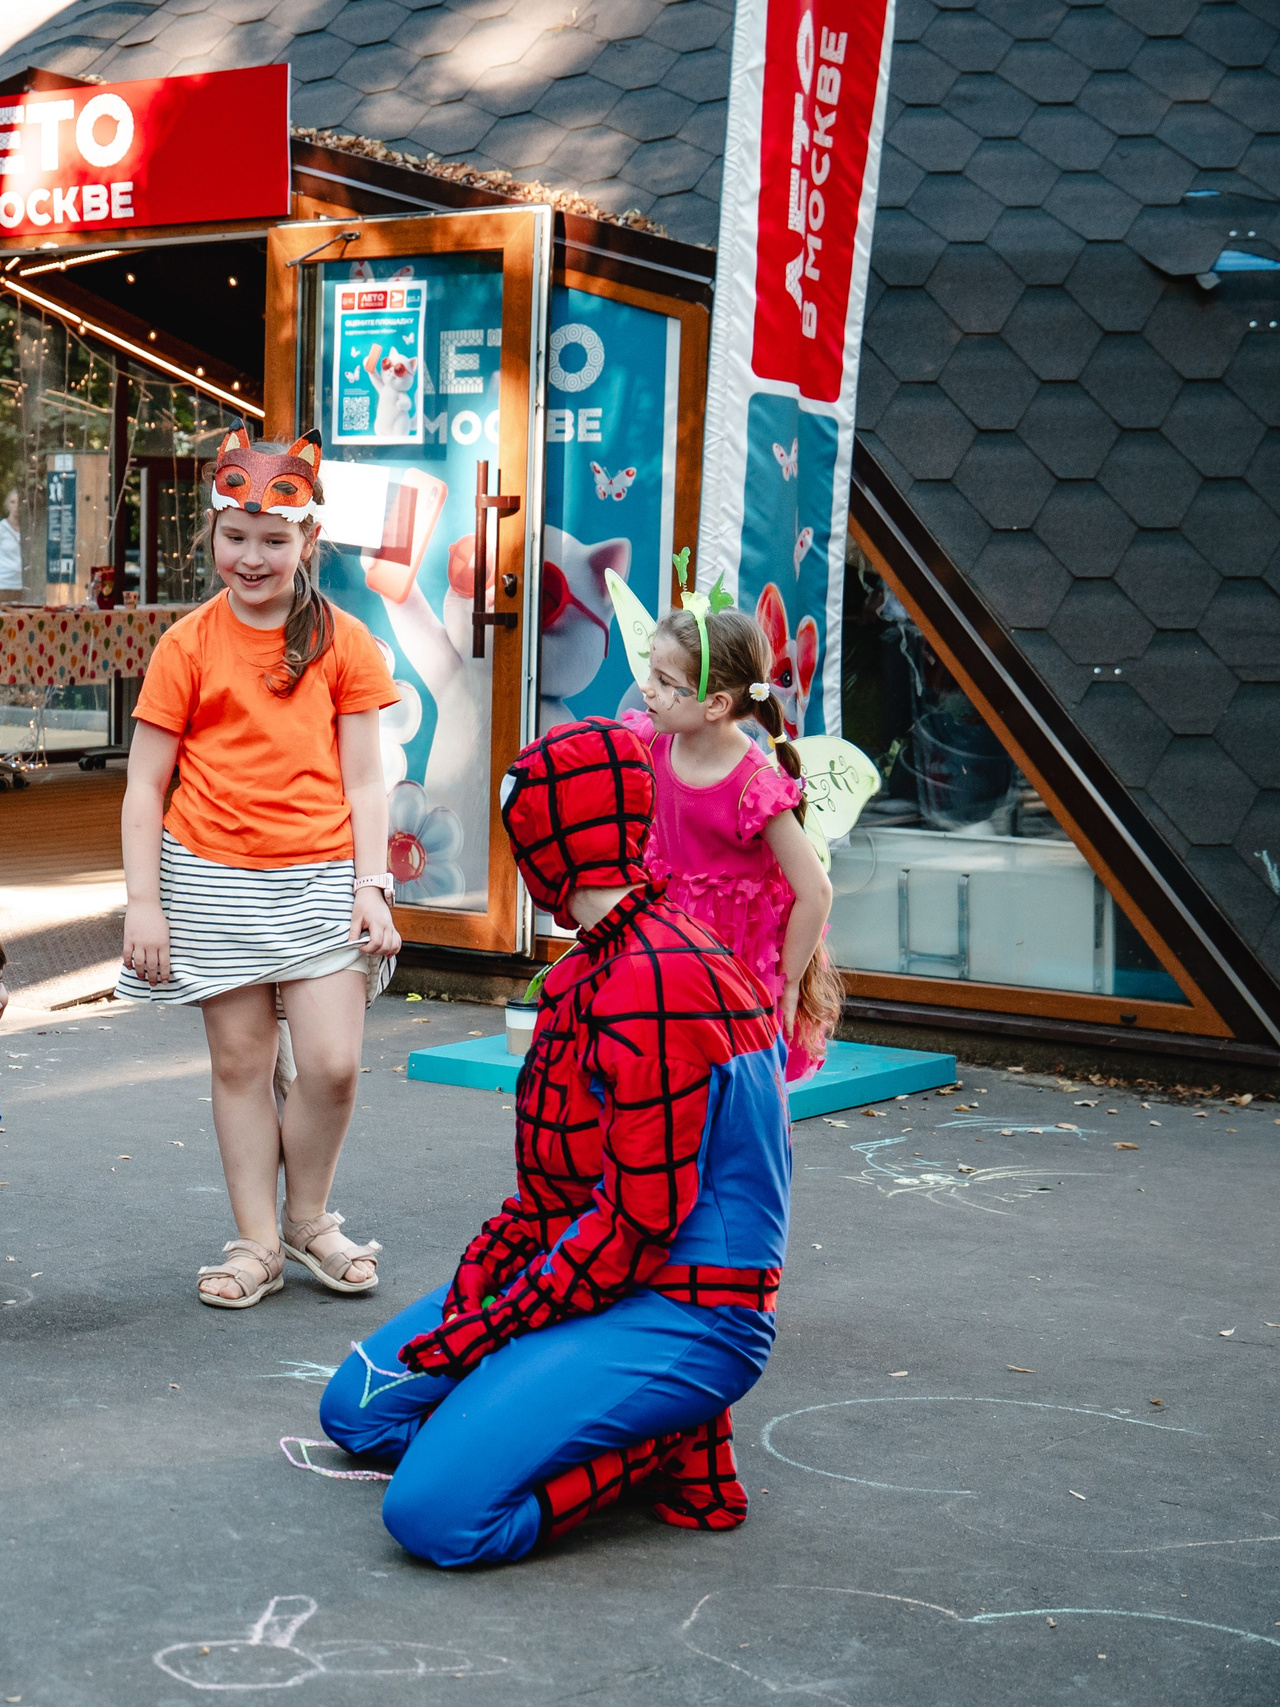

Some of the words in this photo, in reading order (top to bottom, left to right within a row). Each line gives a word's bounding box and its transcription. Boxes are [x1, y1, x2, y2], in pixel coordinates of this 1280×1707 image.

[785, 9, 815, 320] ЛЕТО
[805, 26, 848, 282] МОСКВЕ
[361, 292, 384, 302] ЛЕТО
[802, 300, 818, 340] В
[423, 408, 603, 446] МОСВЕ
